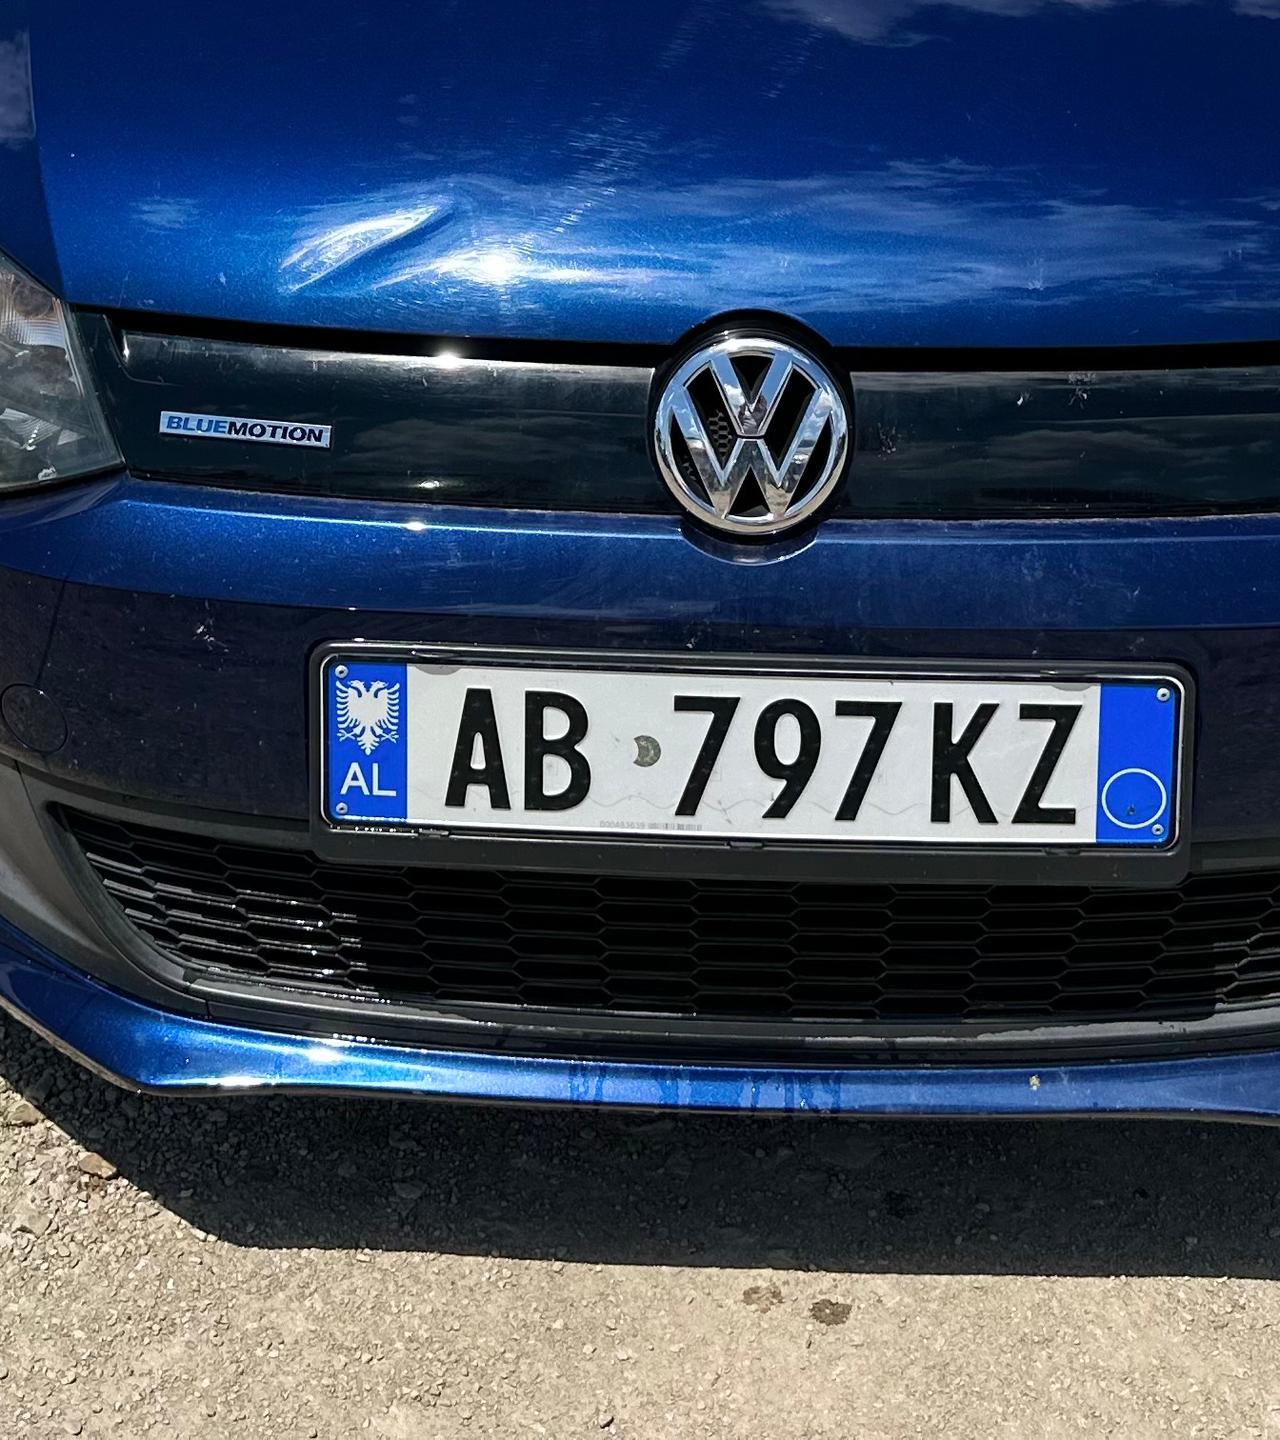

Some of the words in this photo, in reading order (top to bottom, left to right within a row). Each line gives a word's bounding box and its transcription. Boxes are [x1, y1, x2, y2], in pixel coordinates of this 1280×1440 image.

[166, 415, 324, 443] BLUEMOTION
[445, 687, 591, 811] AB
[674, 695, 903, 821] 797
[931, 701, 1083, 824] KZ
[340, 761, 397, 797] AL
